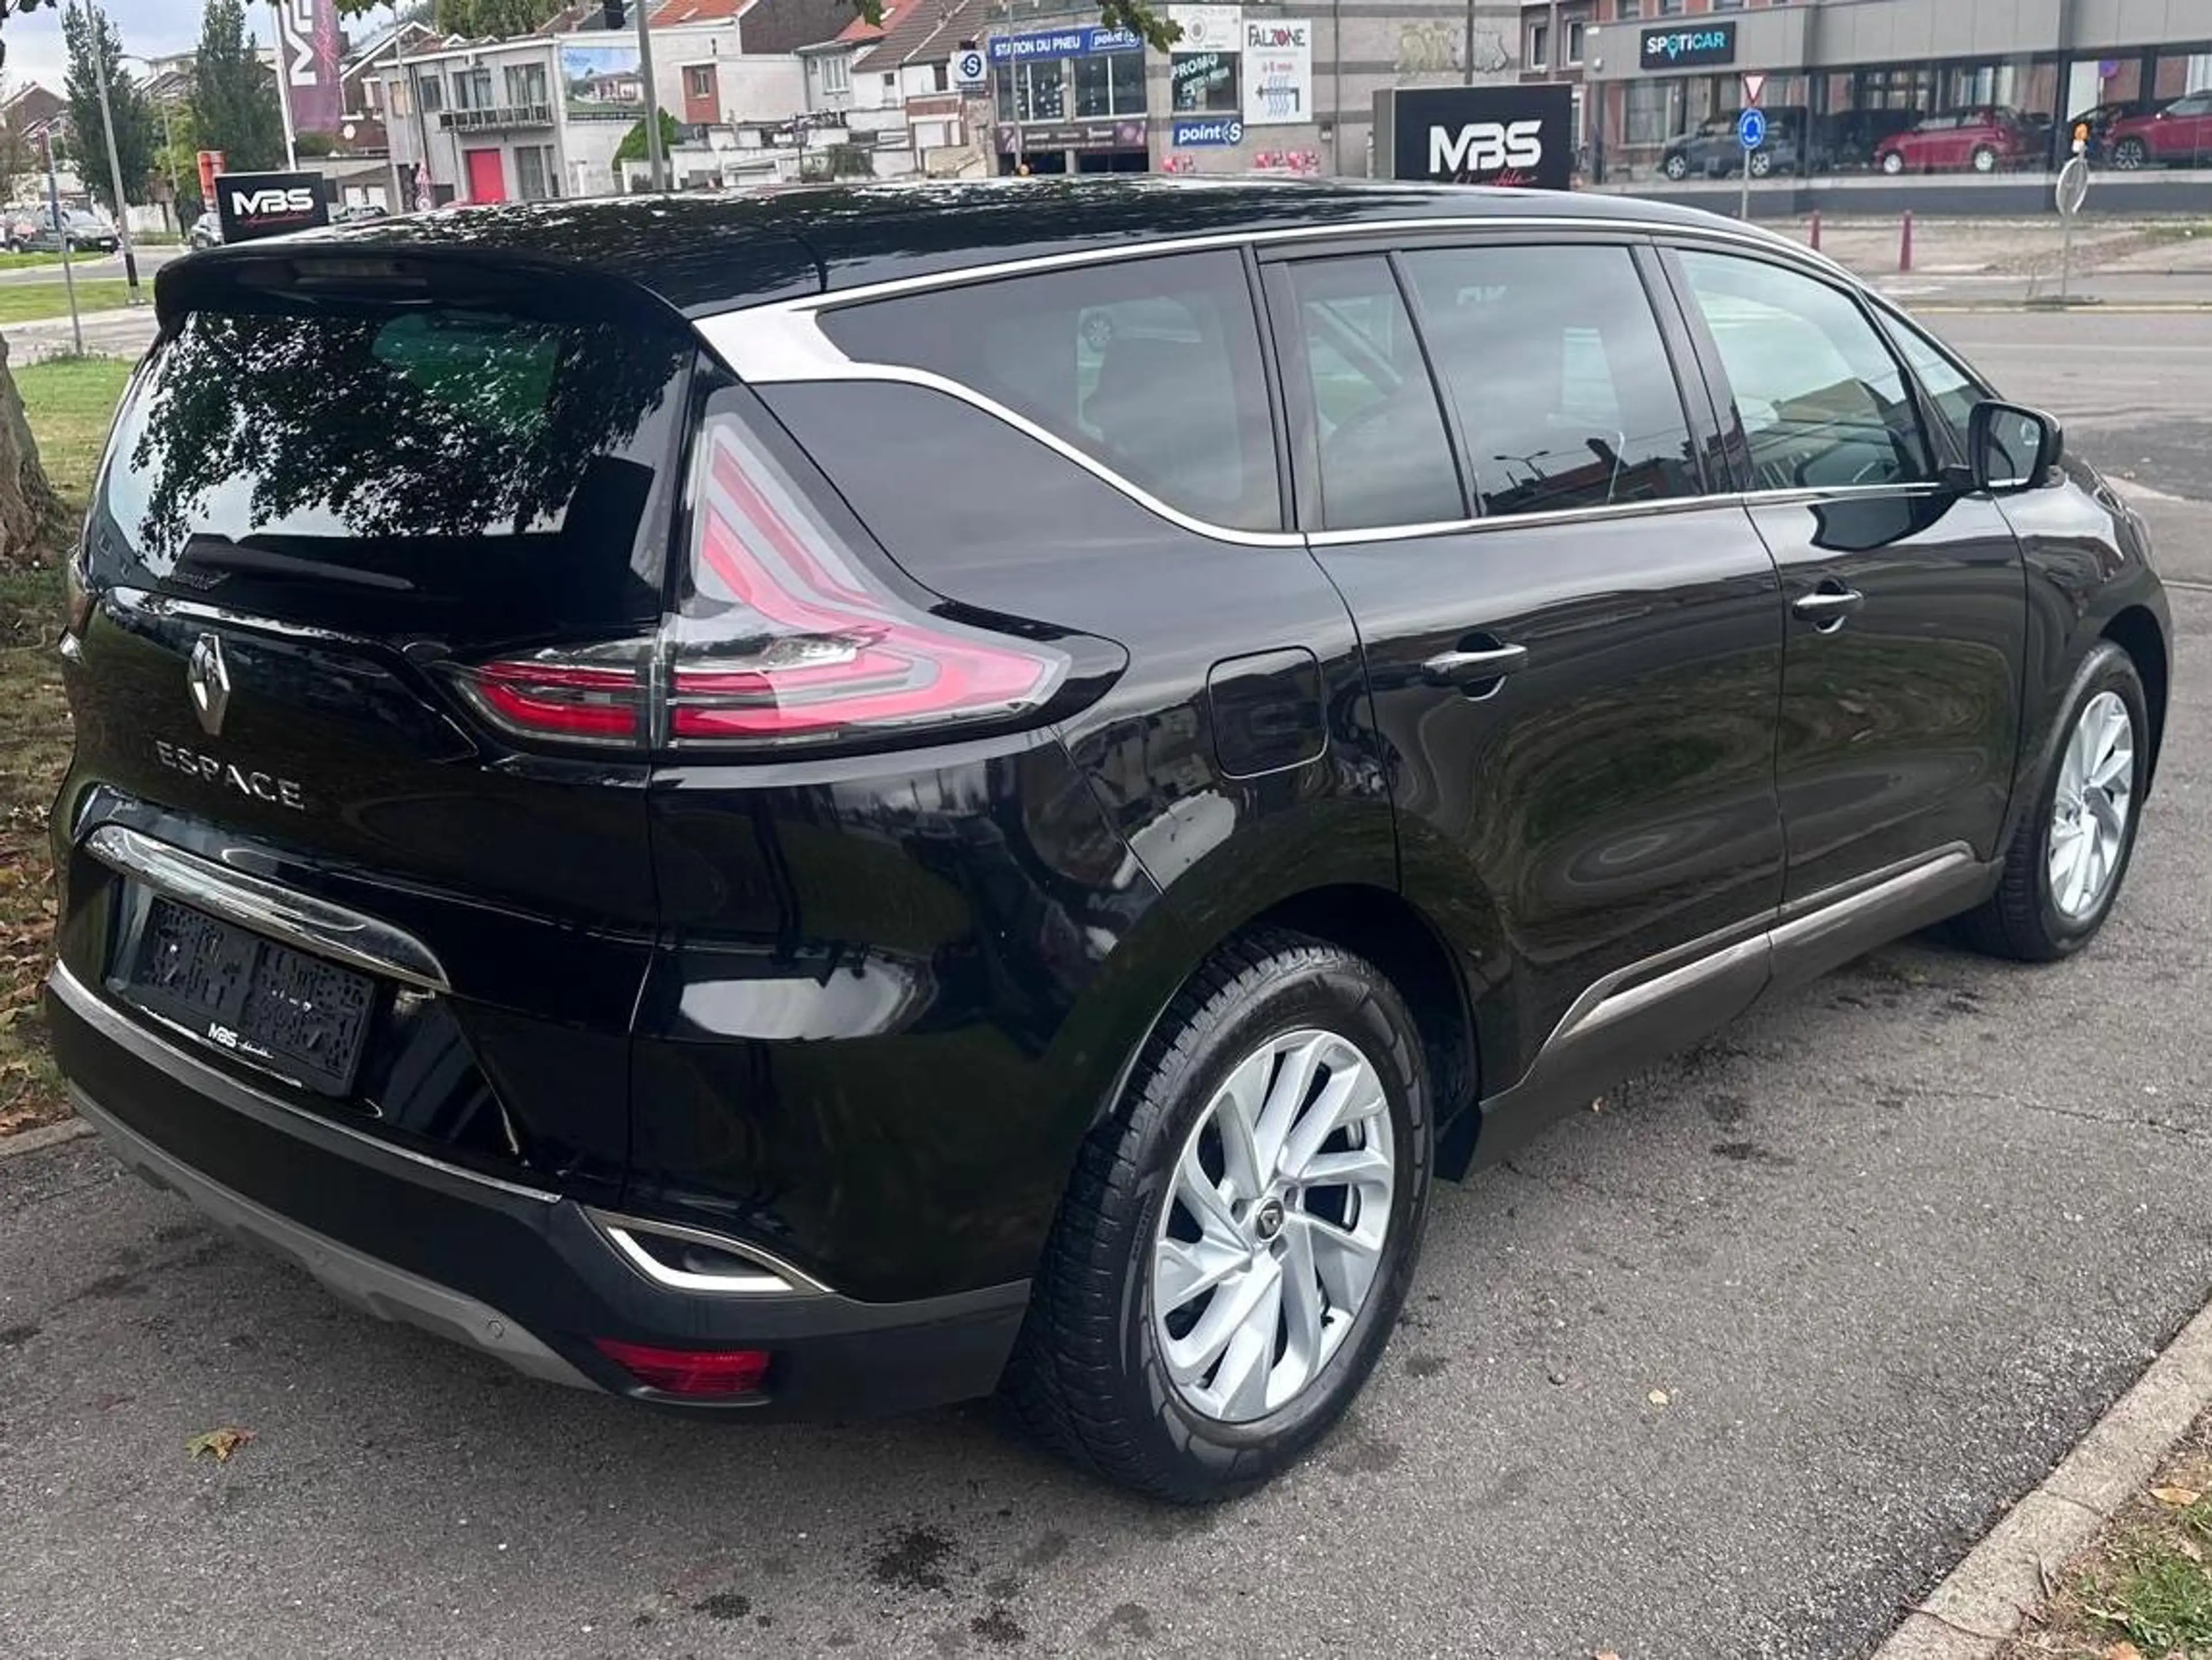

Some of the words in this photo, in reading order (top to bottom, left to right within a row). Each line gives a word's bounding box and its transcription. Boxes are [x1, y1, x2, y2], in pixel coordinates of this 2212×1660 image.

[994, 41, 1035, 56] STATION
[1037, 39, 1050, 52] DU
[1052, 35, 1081, 51] PNEU
[1646, 31, 1725, 60] SPOTICAR
[1179, 123, 1221, 143] point
[1430, 120, 1542, 173] MBS
[232, 187, 314, 216] MBS
[156, 740, 306, 810] ESPACE
[208, 1022, 239, 1048] MBS
